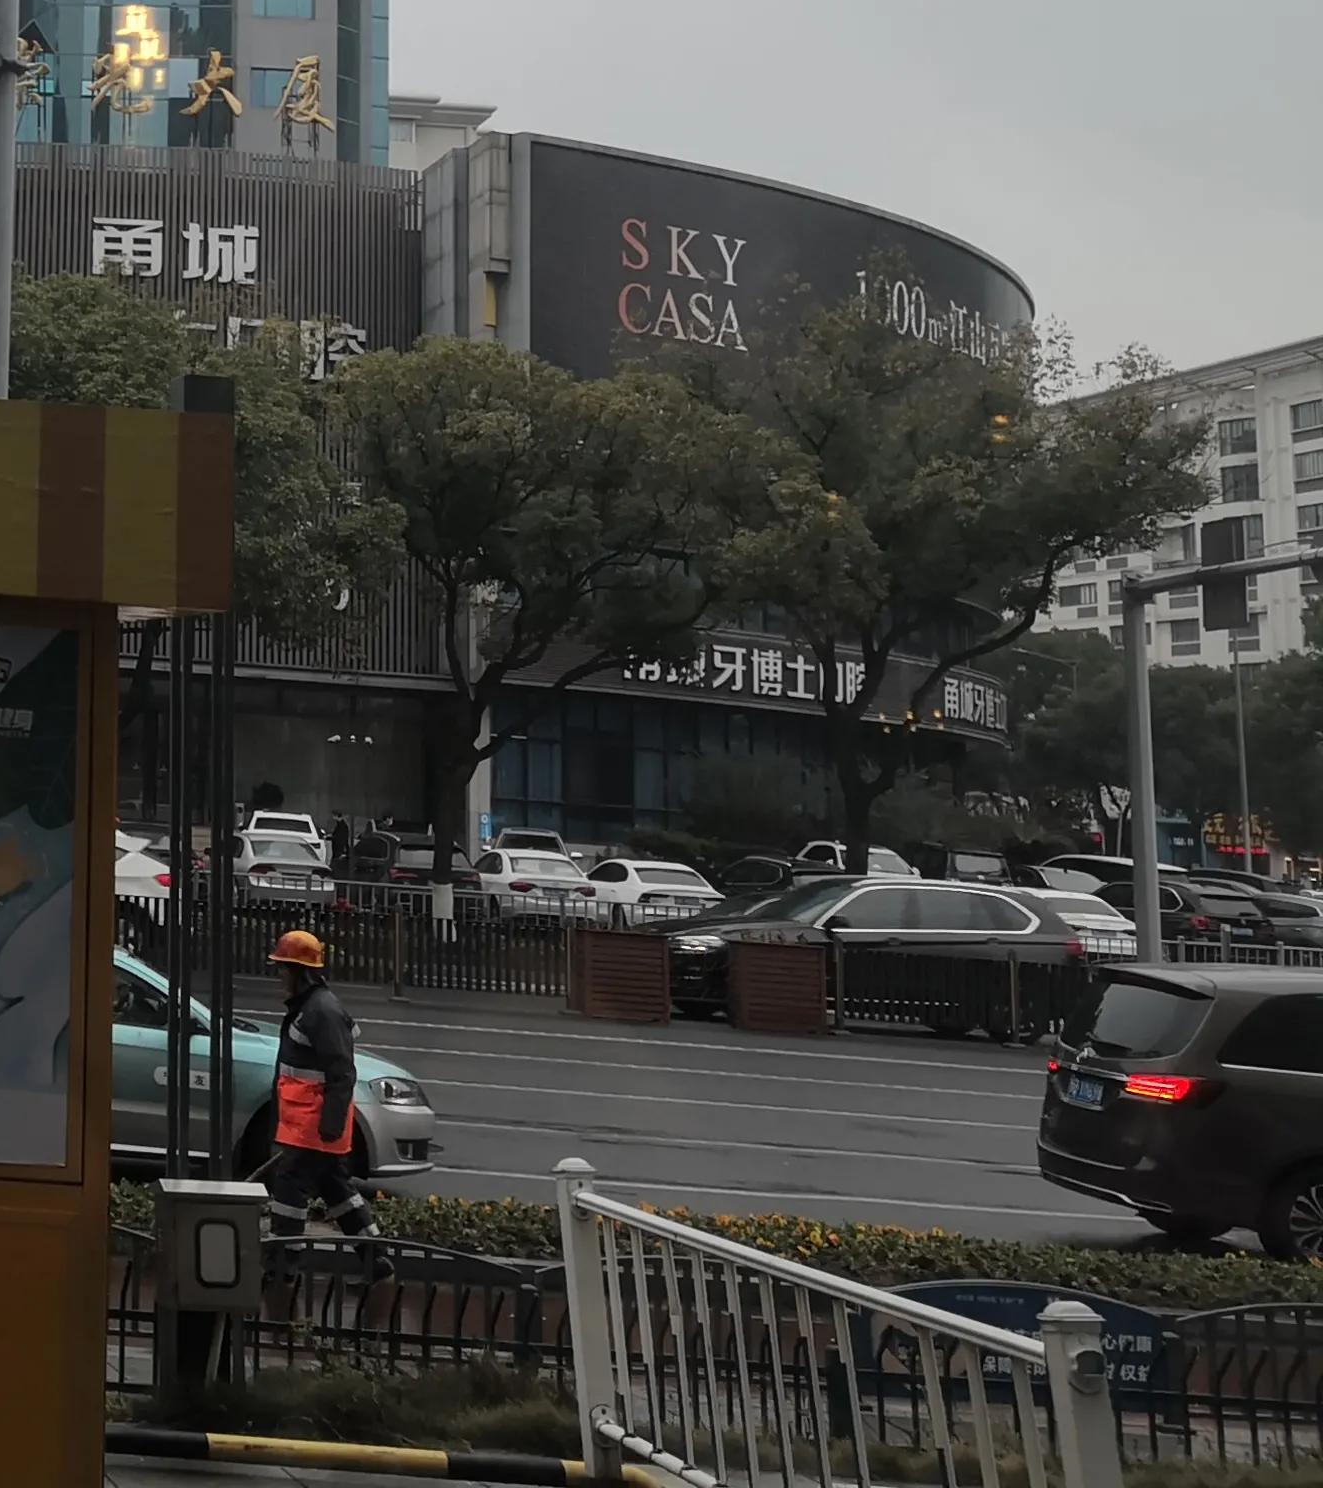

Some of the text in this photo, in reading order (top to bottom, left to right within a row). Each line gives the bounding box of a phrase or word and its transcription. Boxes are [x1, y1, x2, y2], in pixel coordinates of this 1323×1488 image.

[93, 217, 260, 285] 甬城
[621, 218, 746, 288] SKY
[618, 283, 748, 352] CASA
